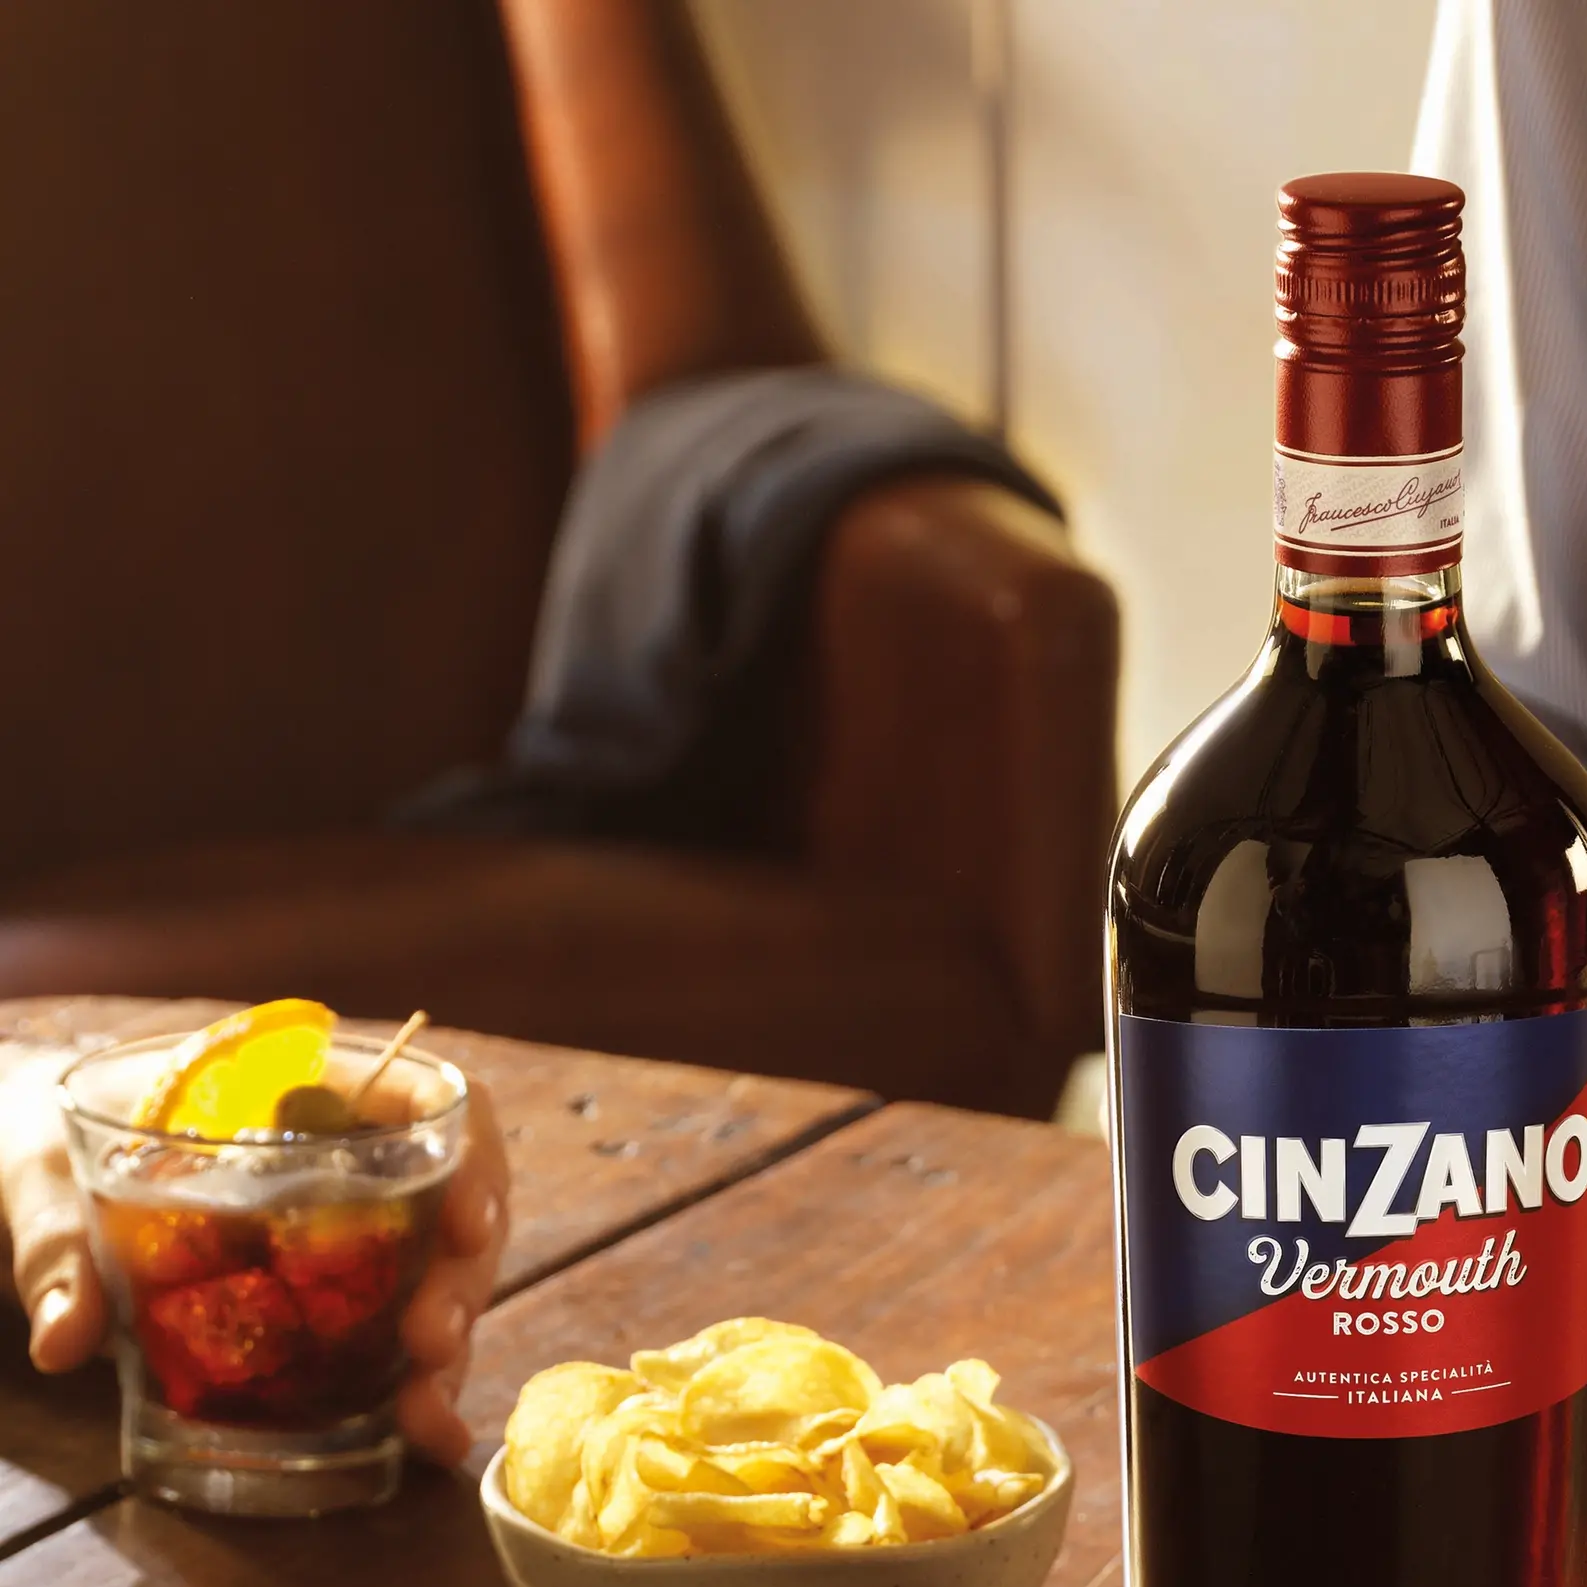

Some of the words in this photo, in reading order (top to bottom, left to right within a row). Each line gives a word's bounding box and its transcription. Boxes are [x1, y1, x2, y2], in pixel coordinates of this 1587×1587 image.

[1439, 514, 1460, 529] ITALIA
[1246, 1229, 1528, 1301] Vermouth
[1332, 1308, 1446, 1336] ROSSO
[1293, 1370, 1393, 1386] AUTENTICA
[1399, 1359, 1494, 1385] SPECIALITÀ
[1347, 1388, 1444, 1404] ITALIANA
